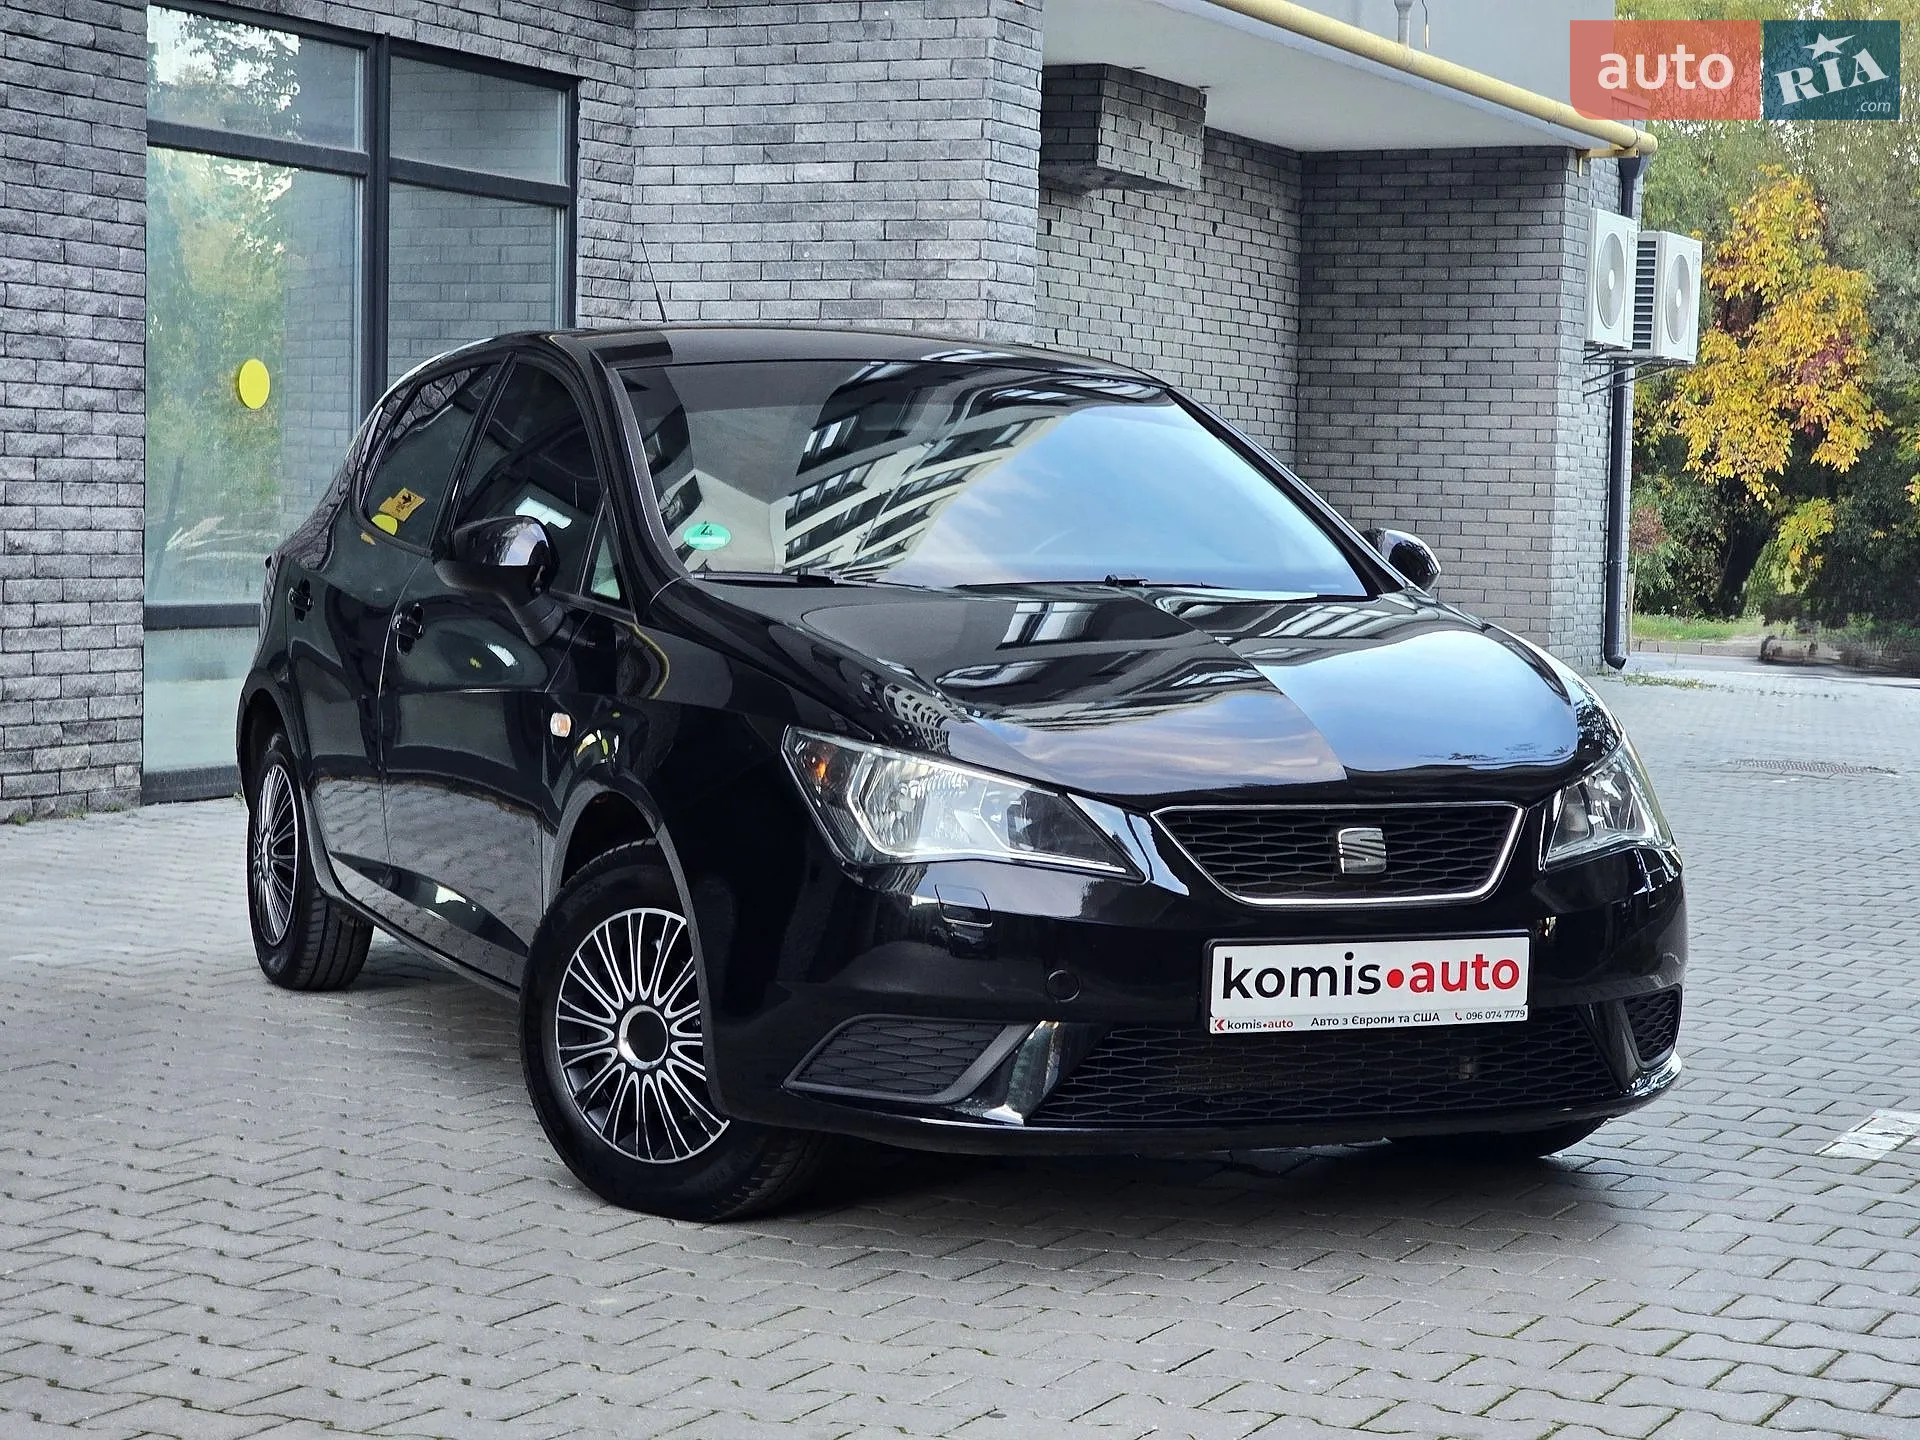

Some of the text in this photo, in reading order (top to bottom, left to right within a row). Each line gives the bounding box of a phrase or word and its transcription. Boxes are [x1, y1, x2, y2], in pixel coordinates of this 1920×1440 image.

[1310, 1016, 1340, 1027] Авто
[1351, 1015, 1395, 1027] Європи
[1398, 1015, 1410, 1023] та
[1413, 1012, 1440, 1023] США
[1466, 1009, 1526, 1020] 096 074 7779
